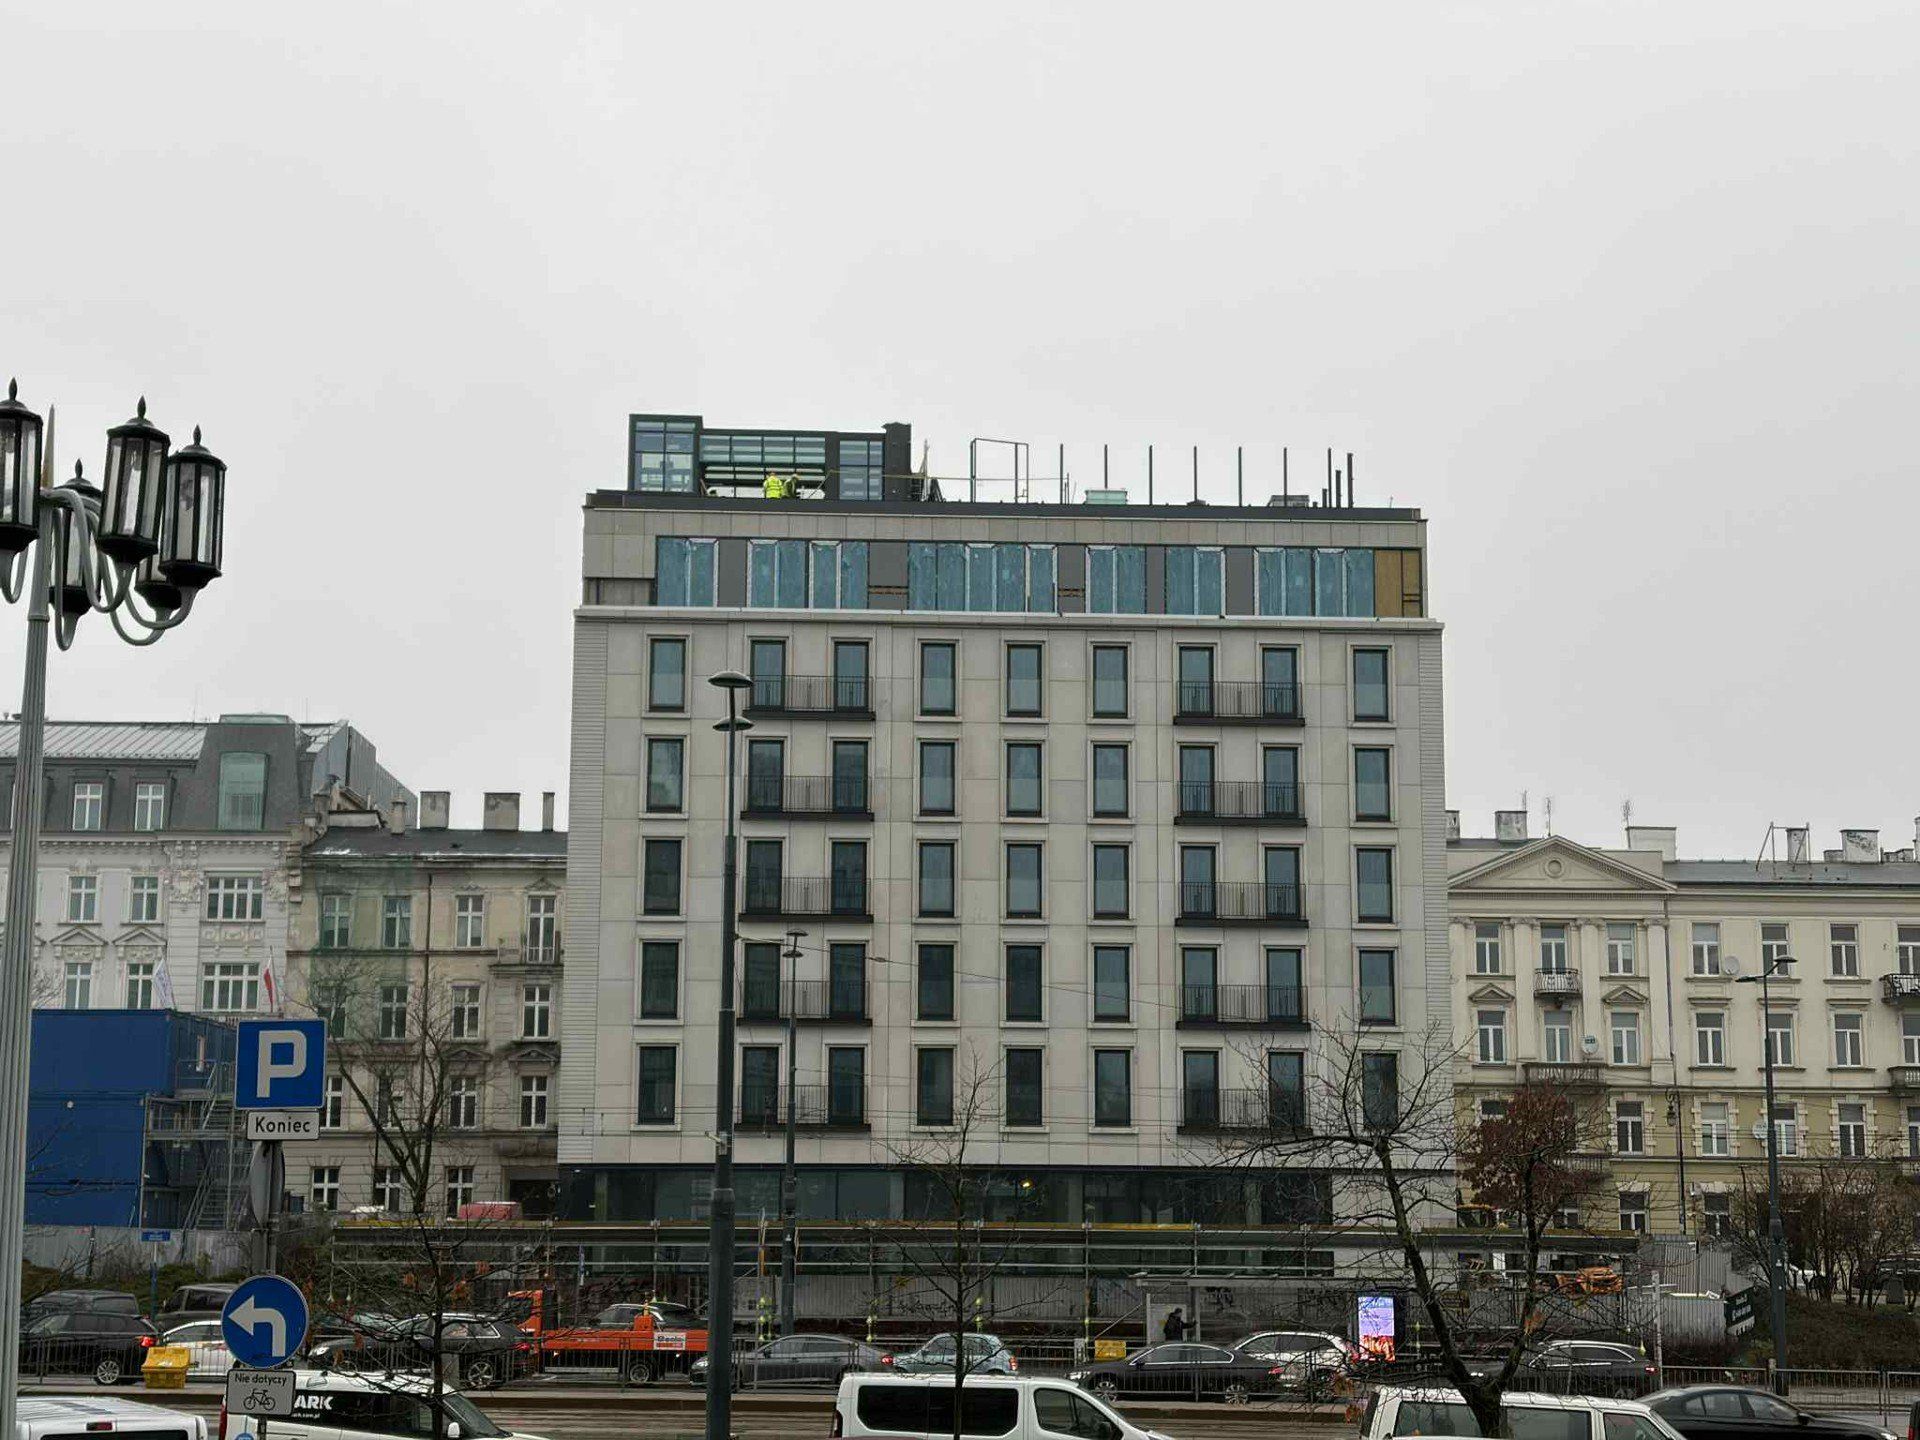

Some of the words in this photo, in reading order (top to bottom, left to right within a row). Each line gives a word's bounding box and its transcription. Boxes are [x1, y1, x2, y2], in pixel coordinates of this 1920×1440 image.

[256, 1029, 307, 1098] P
[255, 1116, 310, 1133] Koniec
[235, 1373, 250, 1384] Nie
[252, 1373, 287, 1387] dotyczy
[294, 1394, 334, 1411] ARK
